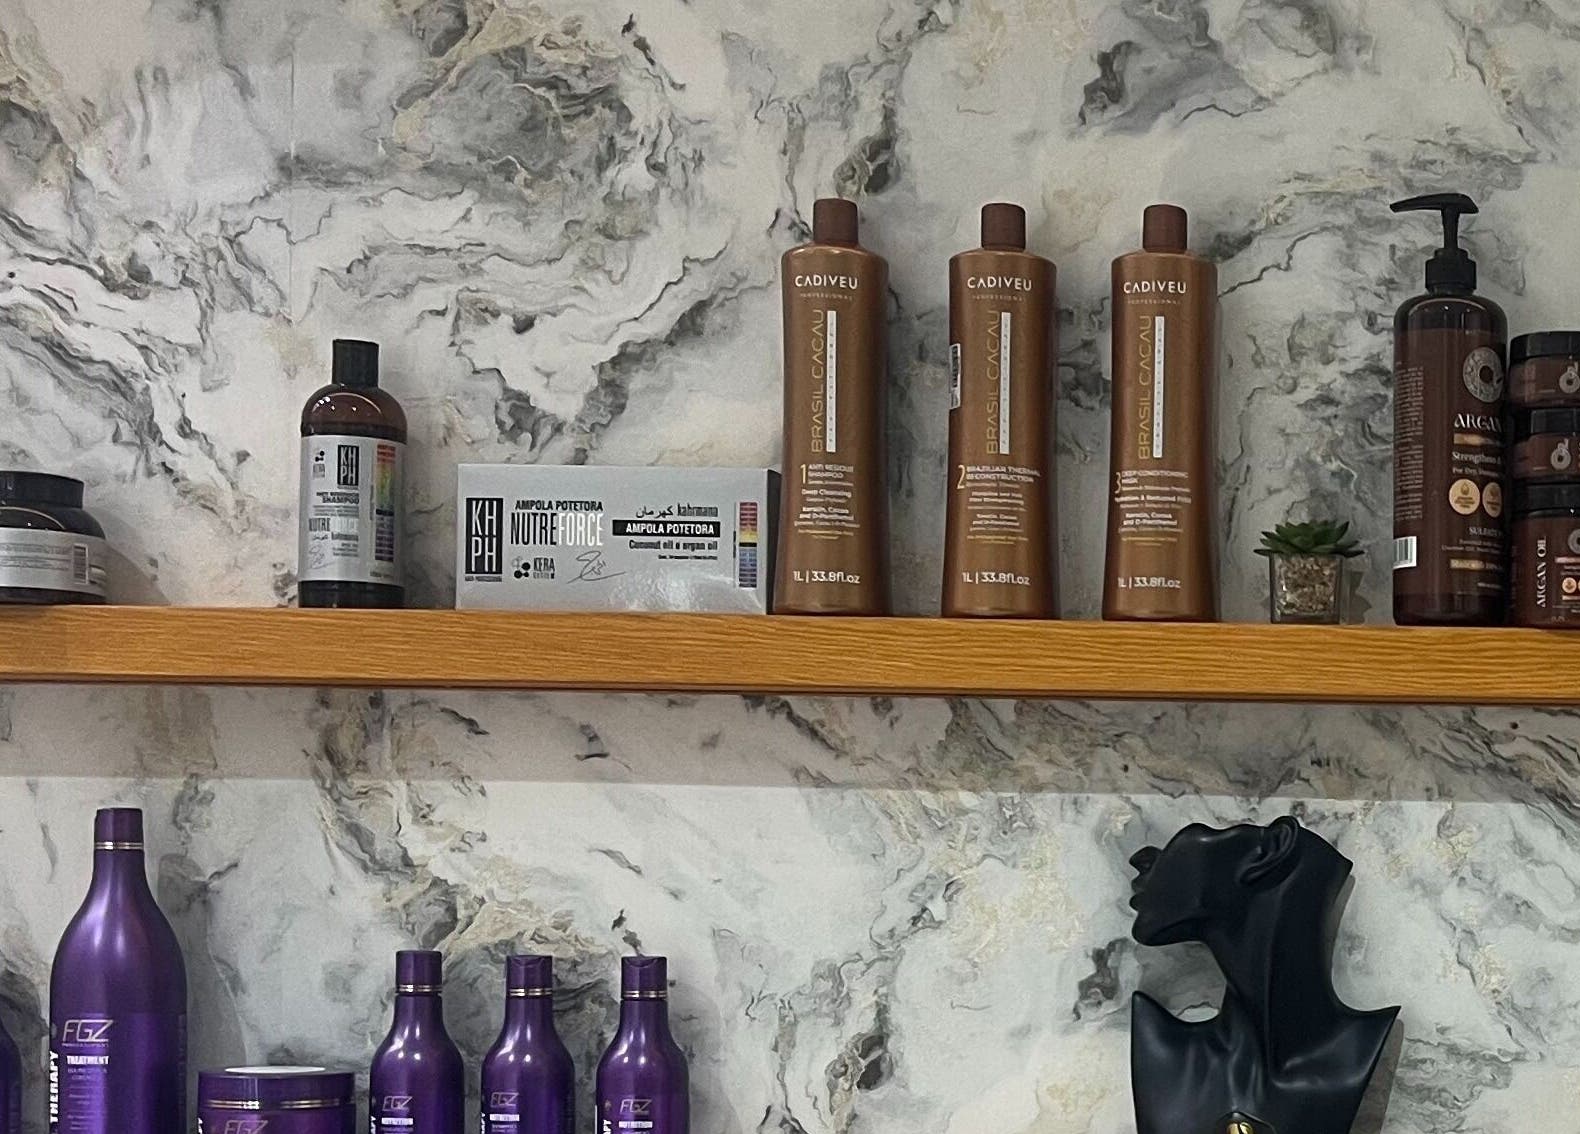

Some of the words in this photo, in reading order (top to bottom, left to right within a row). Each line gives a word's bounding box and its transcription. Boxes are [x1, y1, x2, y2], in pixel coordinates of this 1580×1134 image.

[794, 274, 858, 290] CADIVEU
[967, 276, 1032, 291] CADIVEU
[1123, 280, 1187, 294] CADIVEU
[811, 309, 825, 379] CACAU
[986, 310, 1000, 380] CACAU
[1138, 315, 1152, 386] CACAU
[811, 384, 824, 453] BRASIL
[986, 389, 999, 455] BRASIL
[1138, 391, 1151, 460] BRASIL
[800, 463, 806, 484] 1
[956, 464, 966, 490] 2
[471, 500, 497, 536] KH
[514, 500, 554, 510] AMPOLA
[555, 500, 604, 511] POTETORA
[510, 512, 604, 546] NUTREFORCE
[625, 522, 665, 534] AMPOLA
[666, 523, 715, 535] POTETORA
[471, 536, 497, 572] PH
[62, 1019, 114, 1043] FGZ
[66, 1055, 109, 1065] TREATMENT
[50, 1050, 59, 1124] THERAPY
